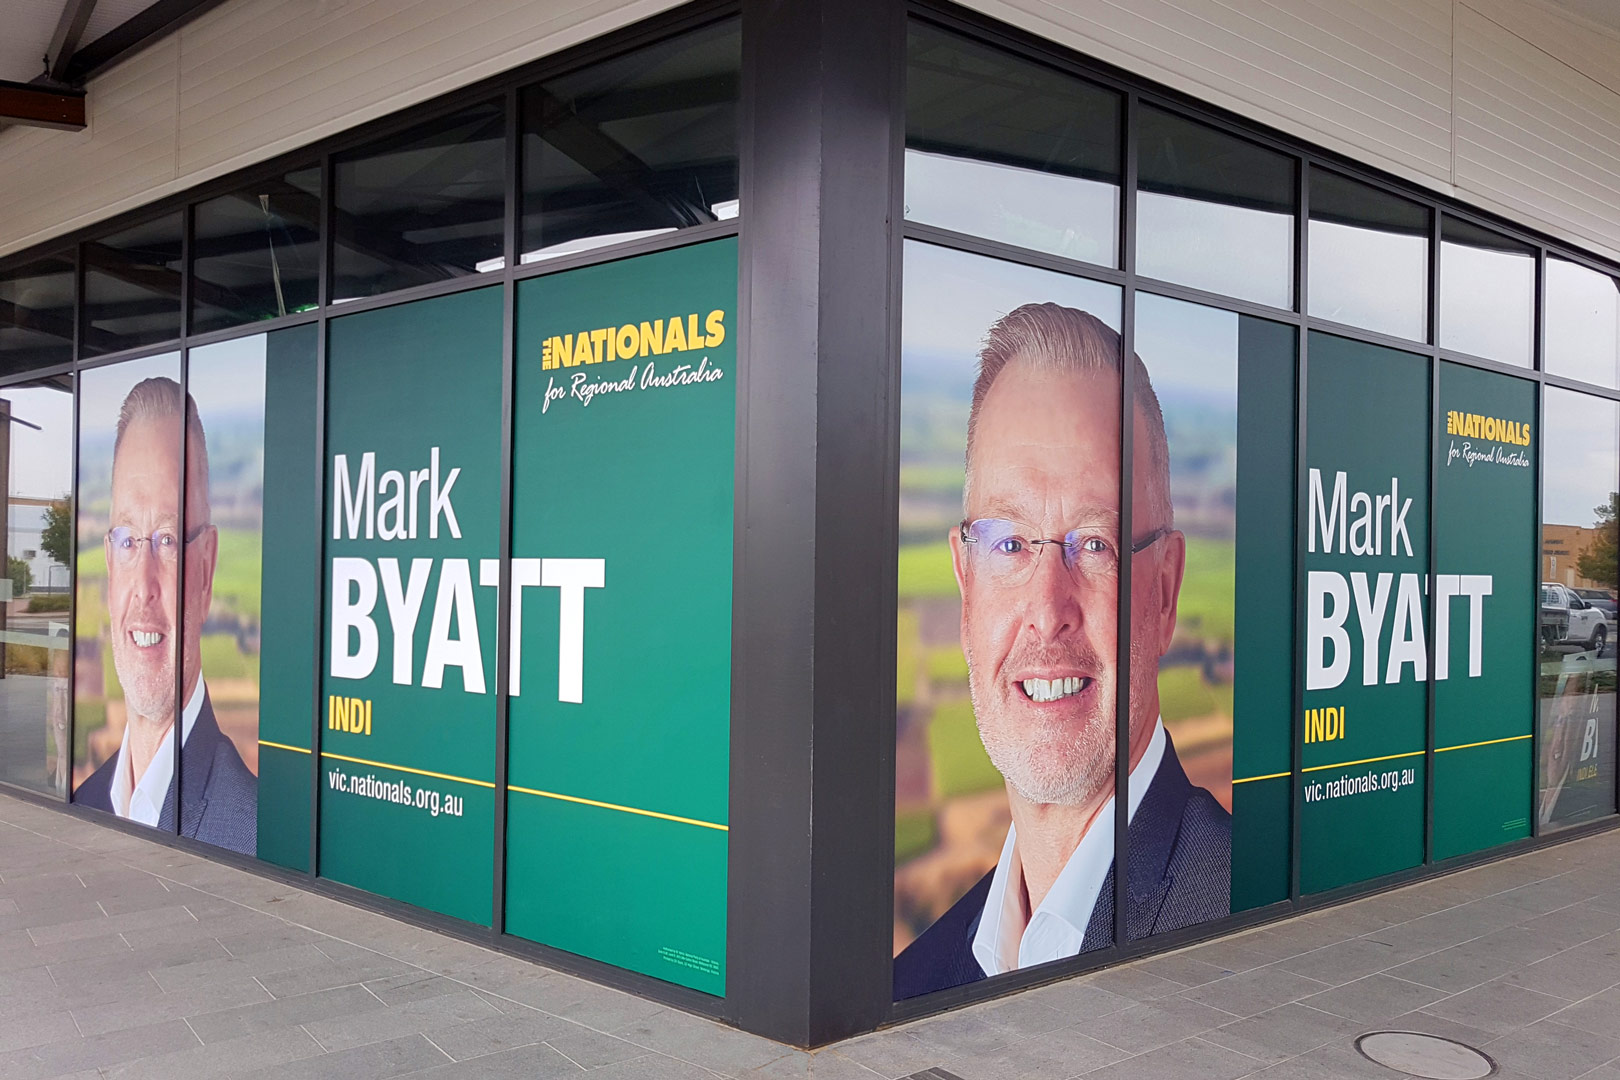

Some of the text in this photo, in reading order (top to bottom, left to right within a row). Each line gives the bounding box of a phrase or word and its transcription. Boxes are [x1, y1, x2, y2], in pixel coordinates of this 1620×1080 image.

[541, 309, 727, 371] THE NATIONALS
[541, 356, 724, 414] for Regional Australia
[1446, 439, 1530, 468] for Regional Australia
[1452, 410, 1531, 446] NATIONALS
[332, 446, 463, 541] Mark
[1307, 467, 1414, 557] Mark
[330, 557, 606, 704] BYATT
[1305, 570, 1493, 691] BYATT
[328, 695, 372, 736] INDI
[1304, 706, 1345, 744] INDI
[328, 767, 464, 817] vic.nationals.org.au
[1304, 768, 1415, 803] vic.nationals.org.au
